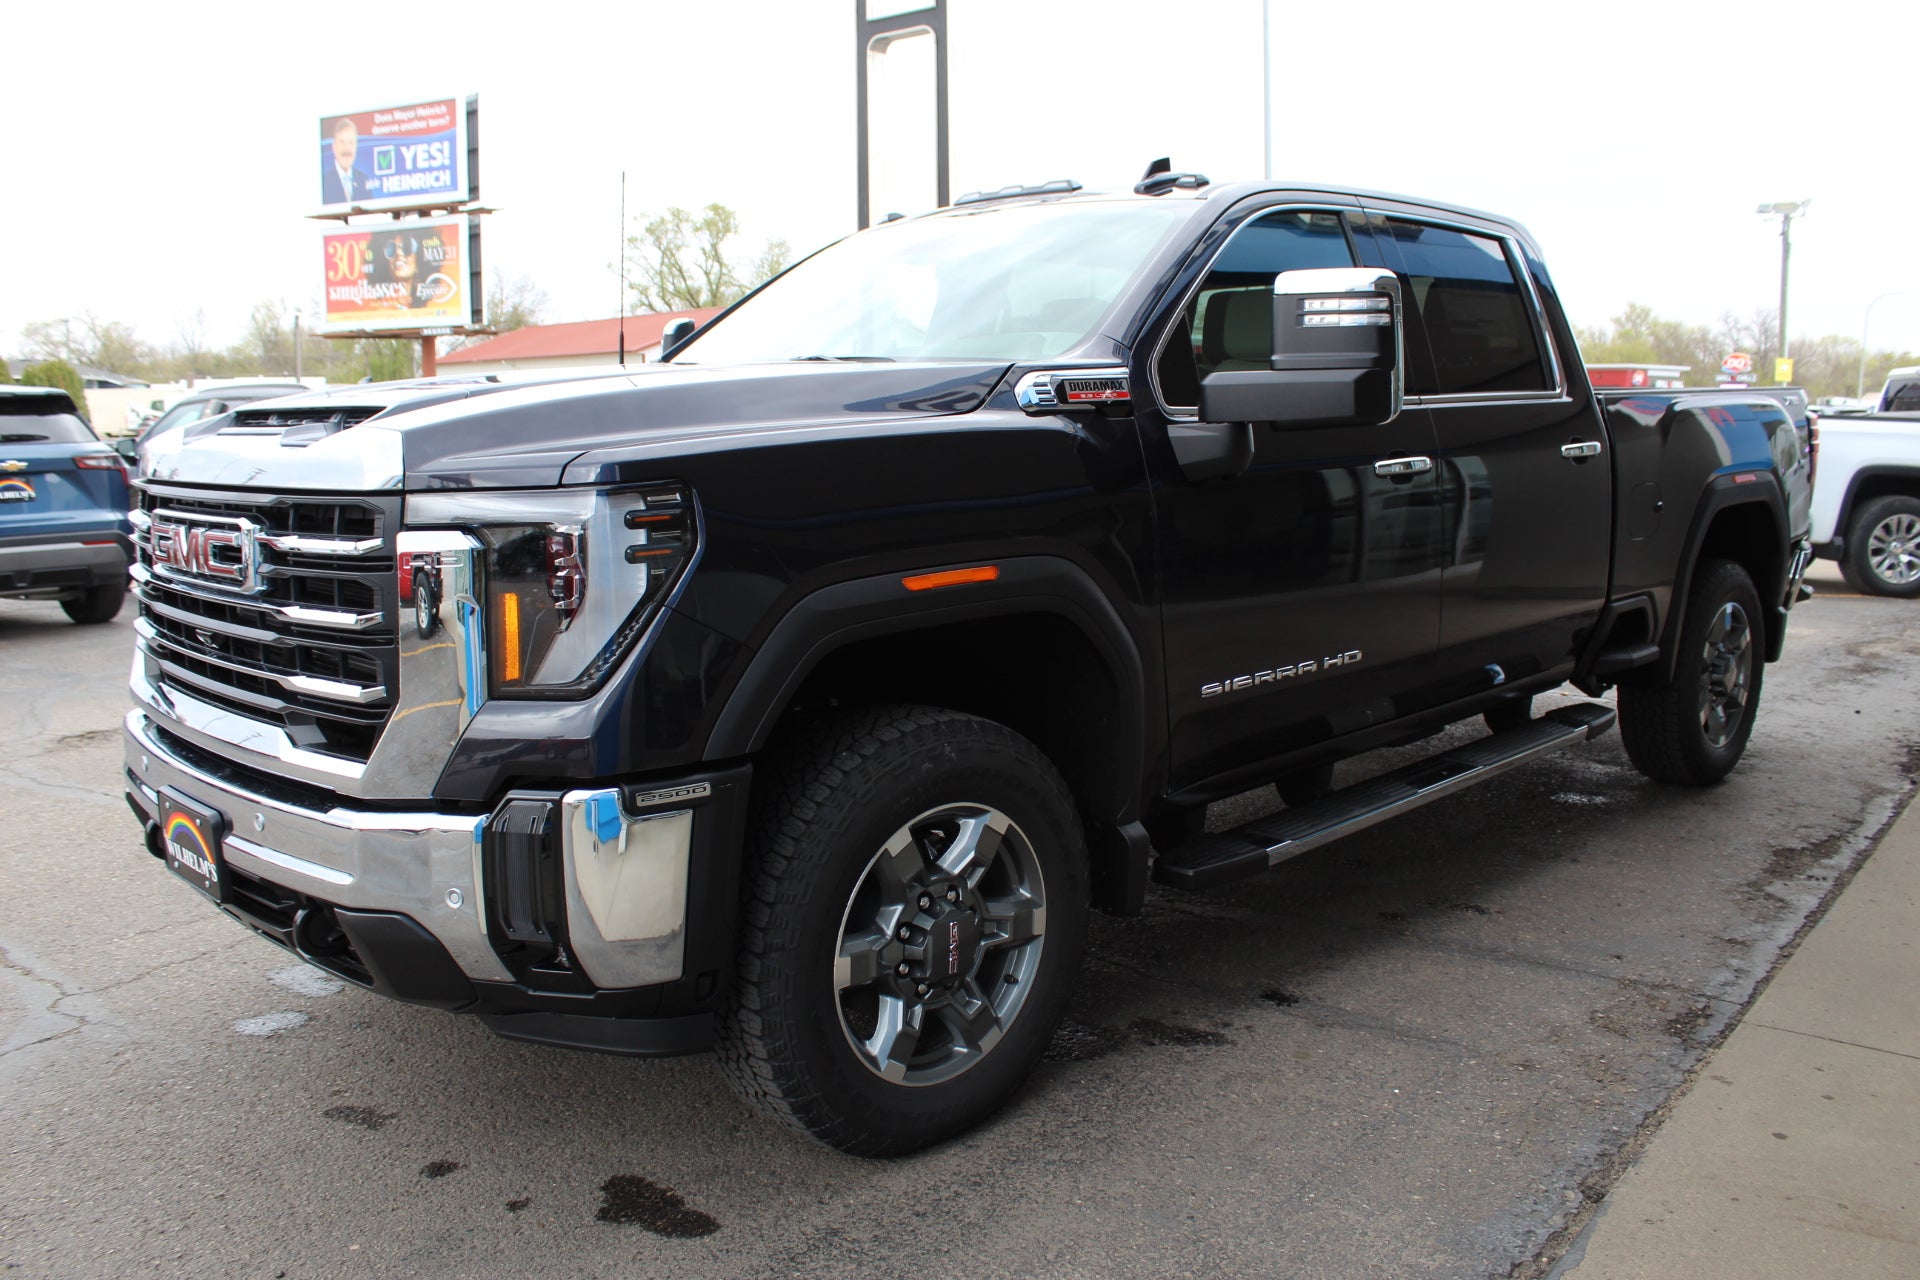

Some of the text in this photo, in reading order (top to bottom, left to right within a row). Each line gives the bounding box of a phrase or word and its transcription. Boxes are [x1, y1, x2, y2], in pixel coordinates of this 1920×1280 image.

[400, 141, 450, 170] YES!
[382, 169, 451, 194] HEINRICH
[423, 245, 457, 260] MAY 31
[328, 279, 407, 306] sunglasses
[1726, 357, 1746, 369] DQ
[1068, 380, 1125, 392] DURAMAX
[151, 521, 243, 581] GMC
[1201, 650, 1362, 698] SIERRA HD
[640, 786, 708, 803] 2500
[164, 837, 219, 883] WILHELM'S
[948, 920, 959, 975] GMC
